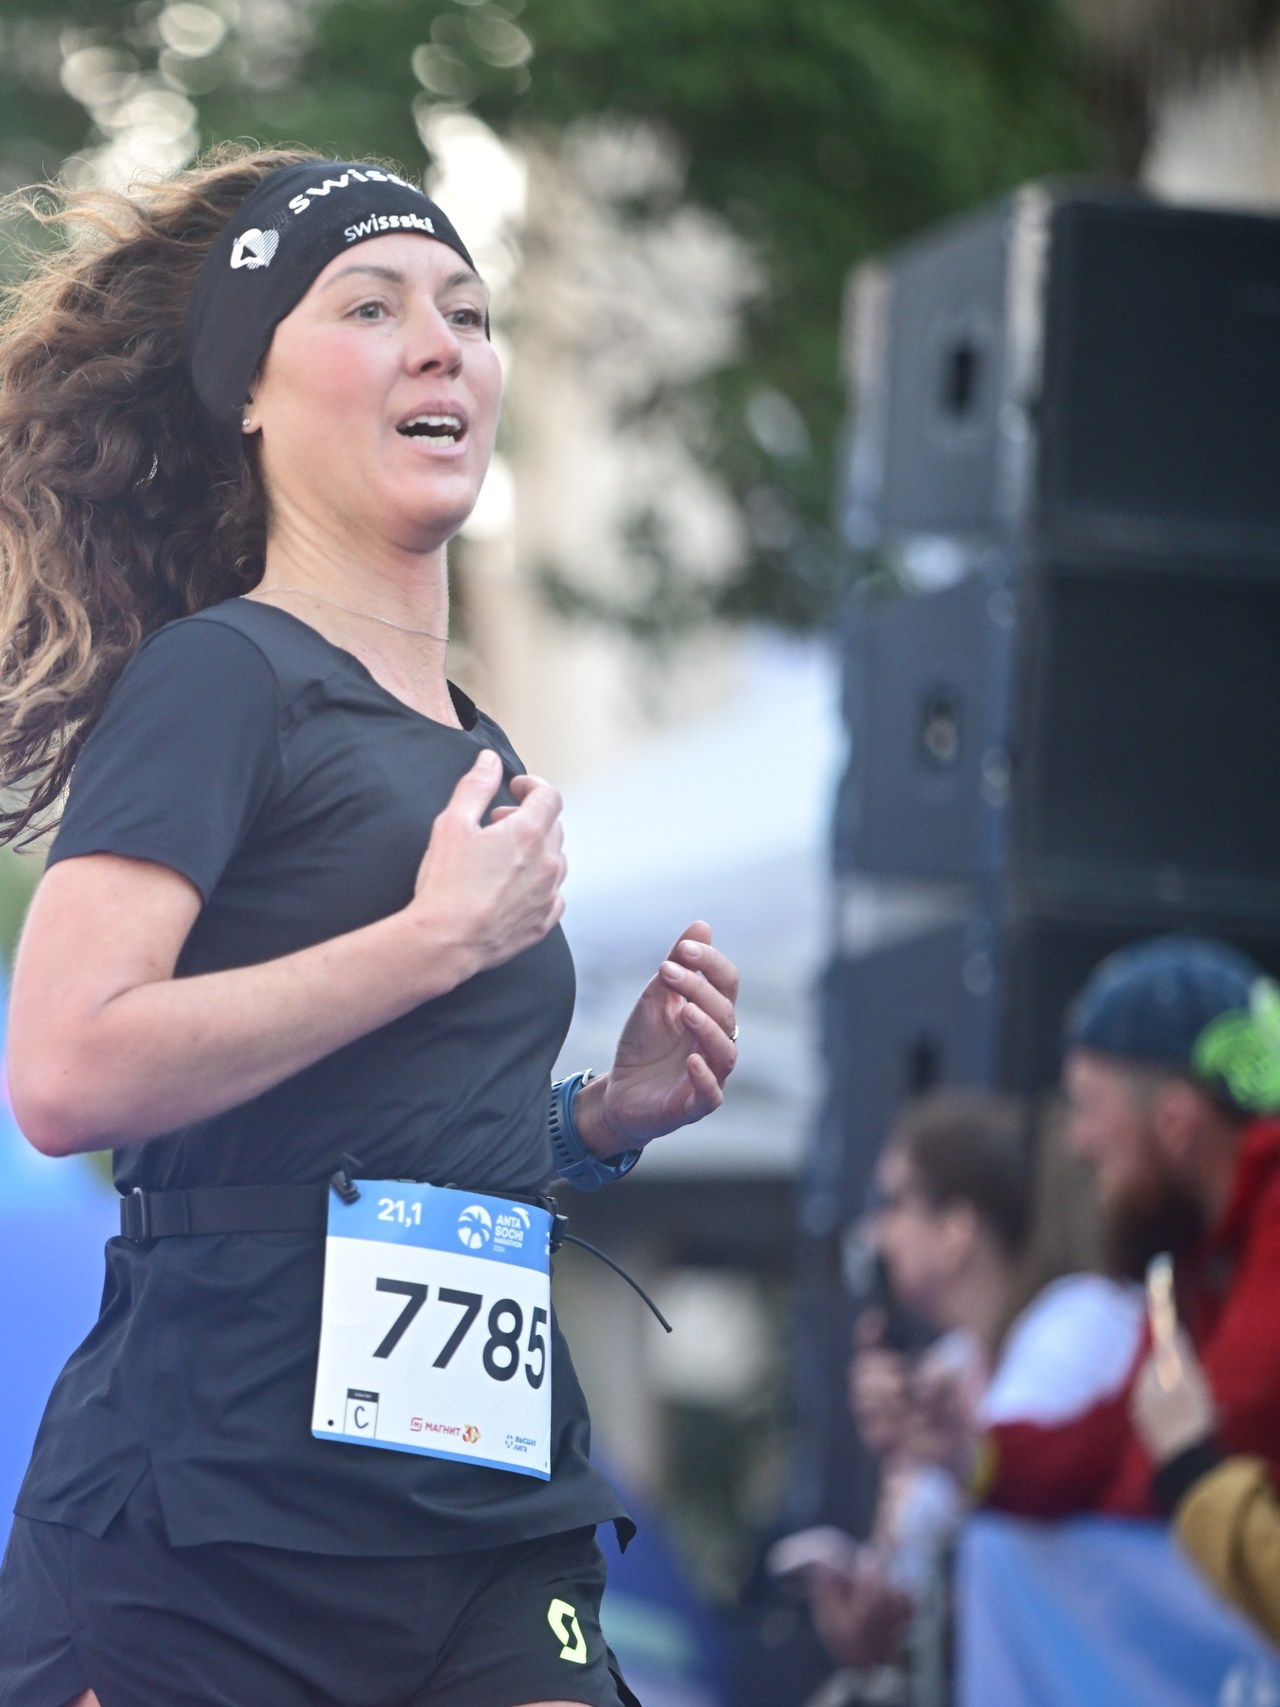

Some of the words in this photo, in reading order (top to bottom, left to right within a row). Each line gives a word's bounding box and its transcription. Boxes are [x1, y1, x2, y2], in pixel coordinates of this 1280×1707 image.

[344, 213, 435, 243] swissski
[377, 1198, 423, 1229] 21,1
[496, 1214, 522, 1230] ANTA
[495, 1225, 524, 1242] SOCHI
[372, 1276, 548, 1390] 7785
[354, 1405, 369, 1429] C
[425, 1422, 461, 1436] МАГНИТ
